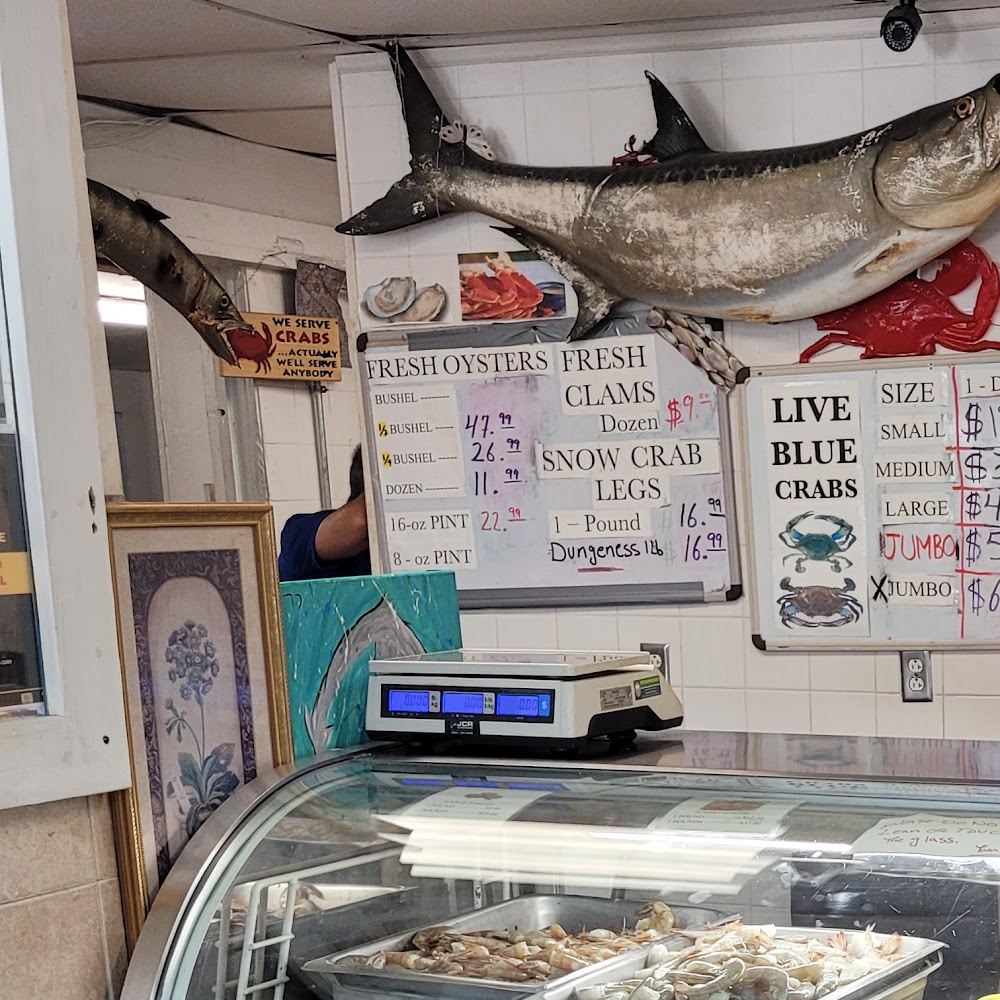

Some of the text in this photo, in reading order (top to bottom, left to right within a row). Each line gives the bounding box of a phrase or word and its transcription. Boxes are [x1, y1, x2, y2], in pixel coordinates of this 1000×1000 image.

[272, 317, 331, 330] WE SERVE
[275, 330, 330, 345] CRABS
[308, 360, 338, 369] SERVE
[365, 350, 548, 379] FRESH OYSTERS
[561, 345, 647, 372] FRESH
[282, 369, 334, 378] ANYBODY
[375, 393, 418, 405] BUSHEL
[565, 380, 656, 407] CLAMS
[881, 382, 936, 404] SIZE
[772, 395, 852, 423] LIVE
[390, 422, 433, 435] BUSHEL
[600, 414, 659, 432] Dozen
[881, 422, 946, 440] SMALL
[393, 453, 436, 465] BUSHEL
[542, 443, 702, 472] SNOW CRAB
[771, 438, 858, 466] BLUE
[875, 460, 955, 478] MEDIUM
[386, 484, 423, 495] DOZEN
[594, 478, 661, 501] LEGS
[775, 478, 858, 500] CRABS
[885, 500, 949, 517] LARGE
[391, 514, 469, 532] 16-oz PINT
[584, 513, 641, 532] Pound
[551, 542, 641, 565] Dungeness
[884, 533, 957, 561] JUMBO
[393, 549, 473, 566] 8 oz PINT
